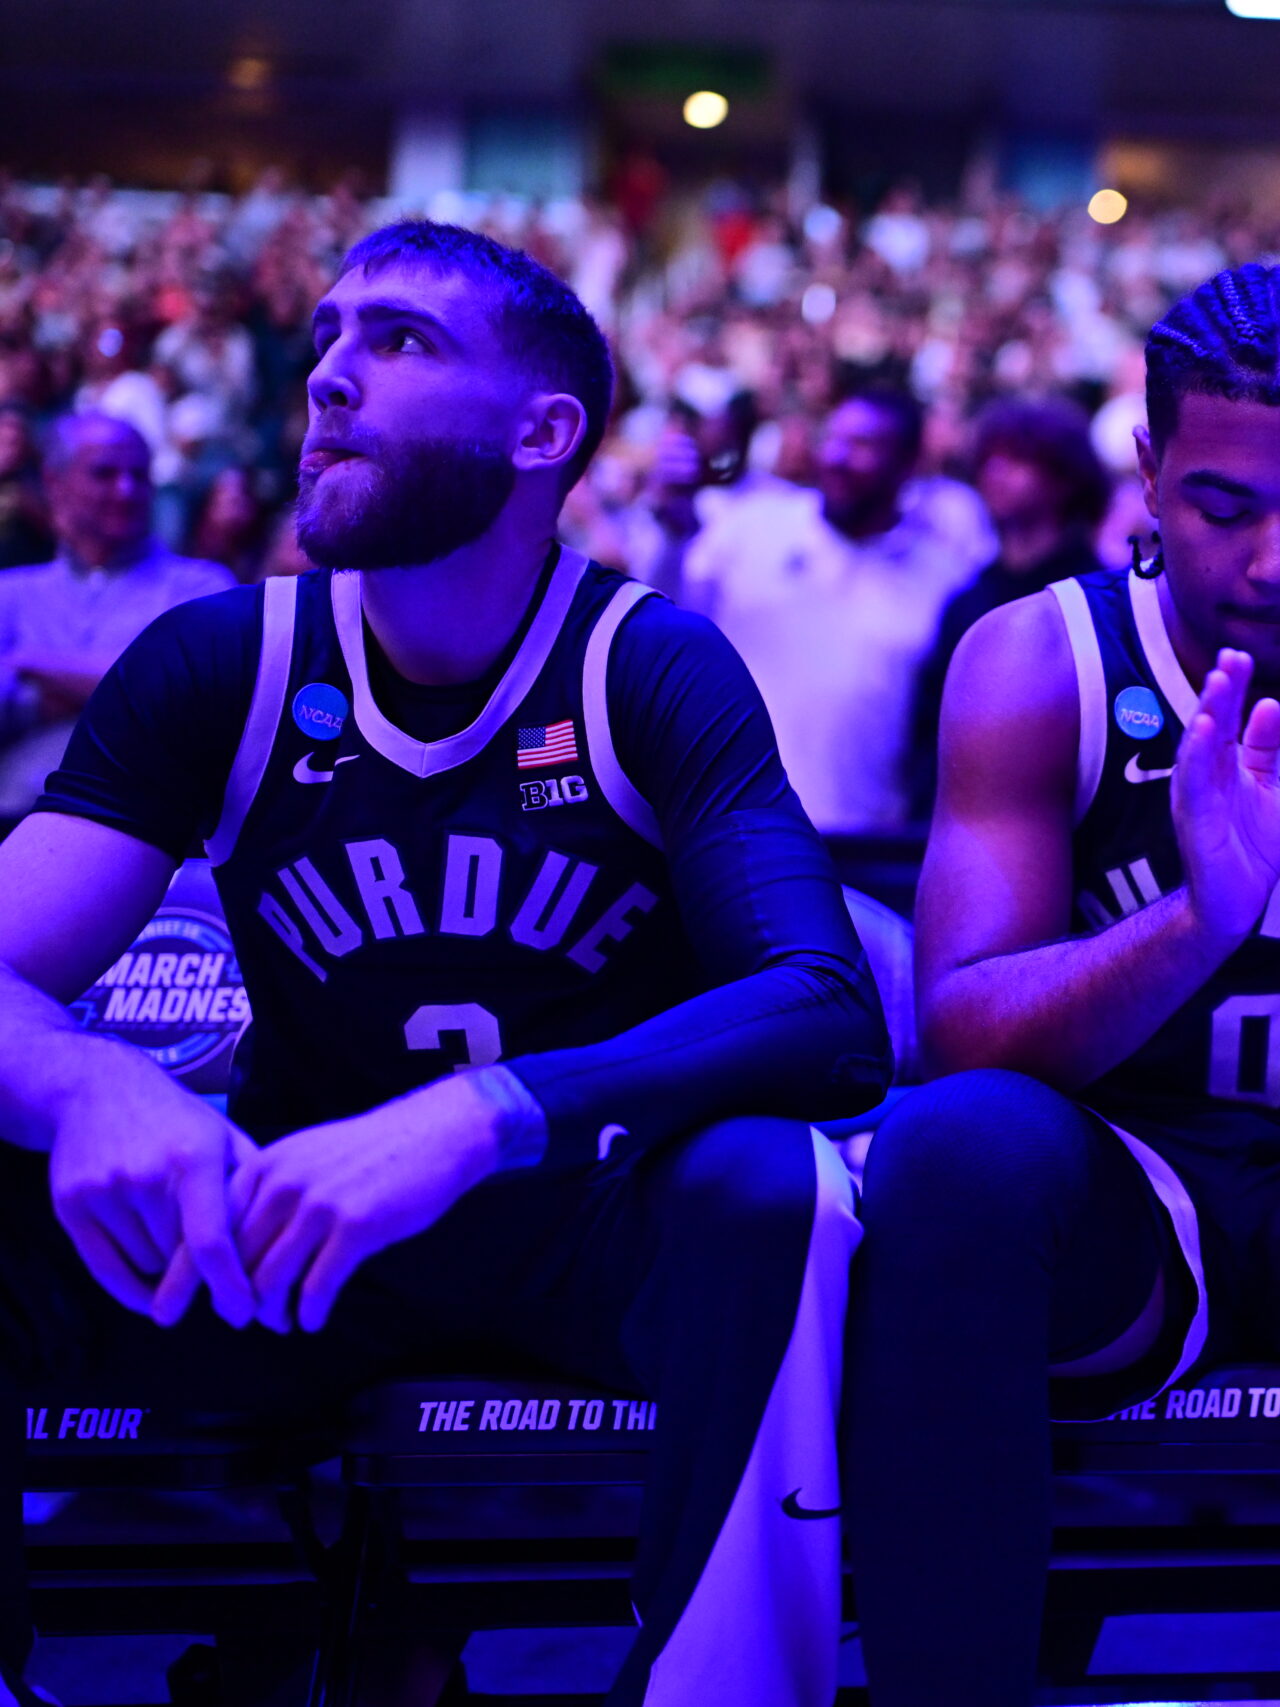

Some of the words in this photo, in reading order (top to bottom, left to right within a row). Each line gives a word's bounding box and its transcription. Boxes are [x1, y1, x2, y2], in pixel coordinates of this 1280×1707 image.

[300, 704, 344, 731] NCAA
[1119, 708, 1160, 728] NCAA
[256, 833, 660, 984] PURDUE
[95, 952, 226, 987] MARCH
[103, 986, 252, 1022] MADNES
[418, 1400, 475, 1432] THE
[479, 1399, 561, 1431] ROAD
[567, 1399, 605, 1431] TO
[1165, 1388, 1242, 1420] ROAD
[57, 1407, 144, 1440] FOUR
